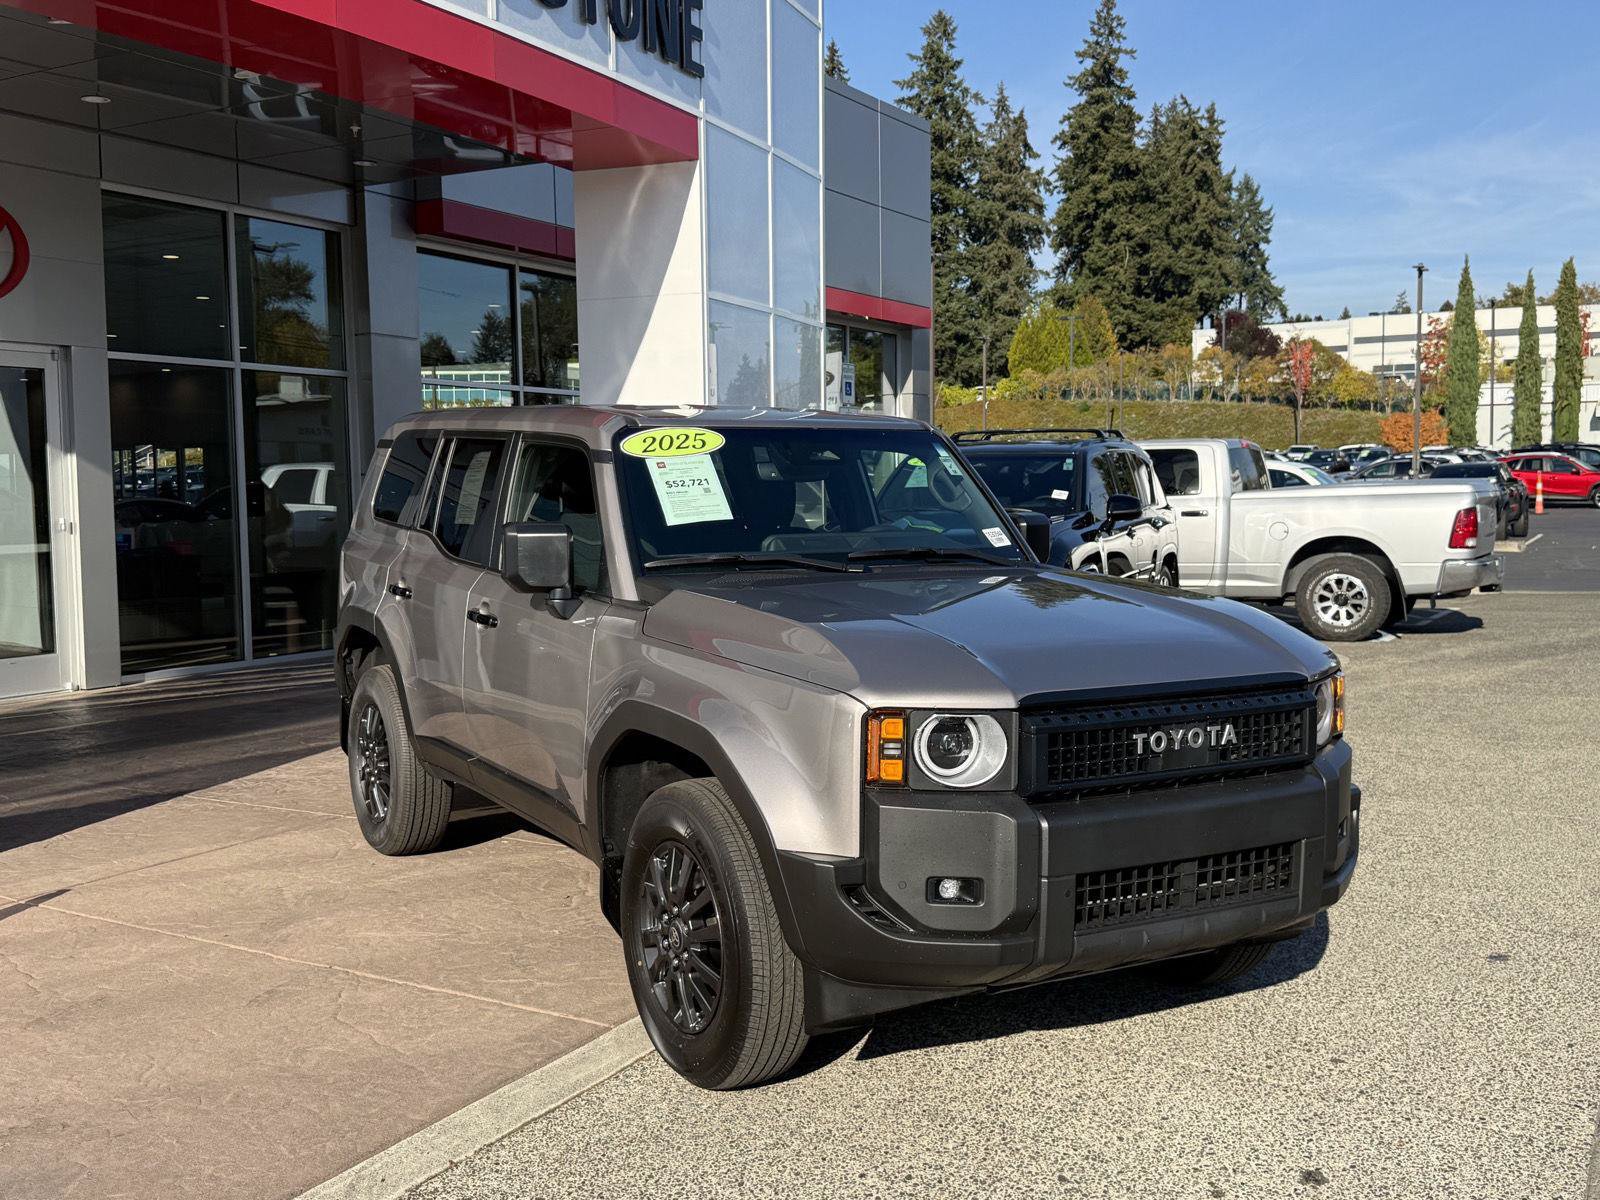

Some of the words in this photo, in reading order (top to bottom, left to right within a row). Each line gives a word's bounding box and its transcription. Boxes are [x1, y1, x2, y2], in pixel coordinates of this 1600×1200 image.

[536, 0, 704, 78] ONE
[642, 433, 706, 453] 2025
[665, 478, 710, 489] $52,721
[1133, 724, 1238, 754] TOYOTA
